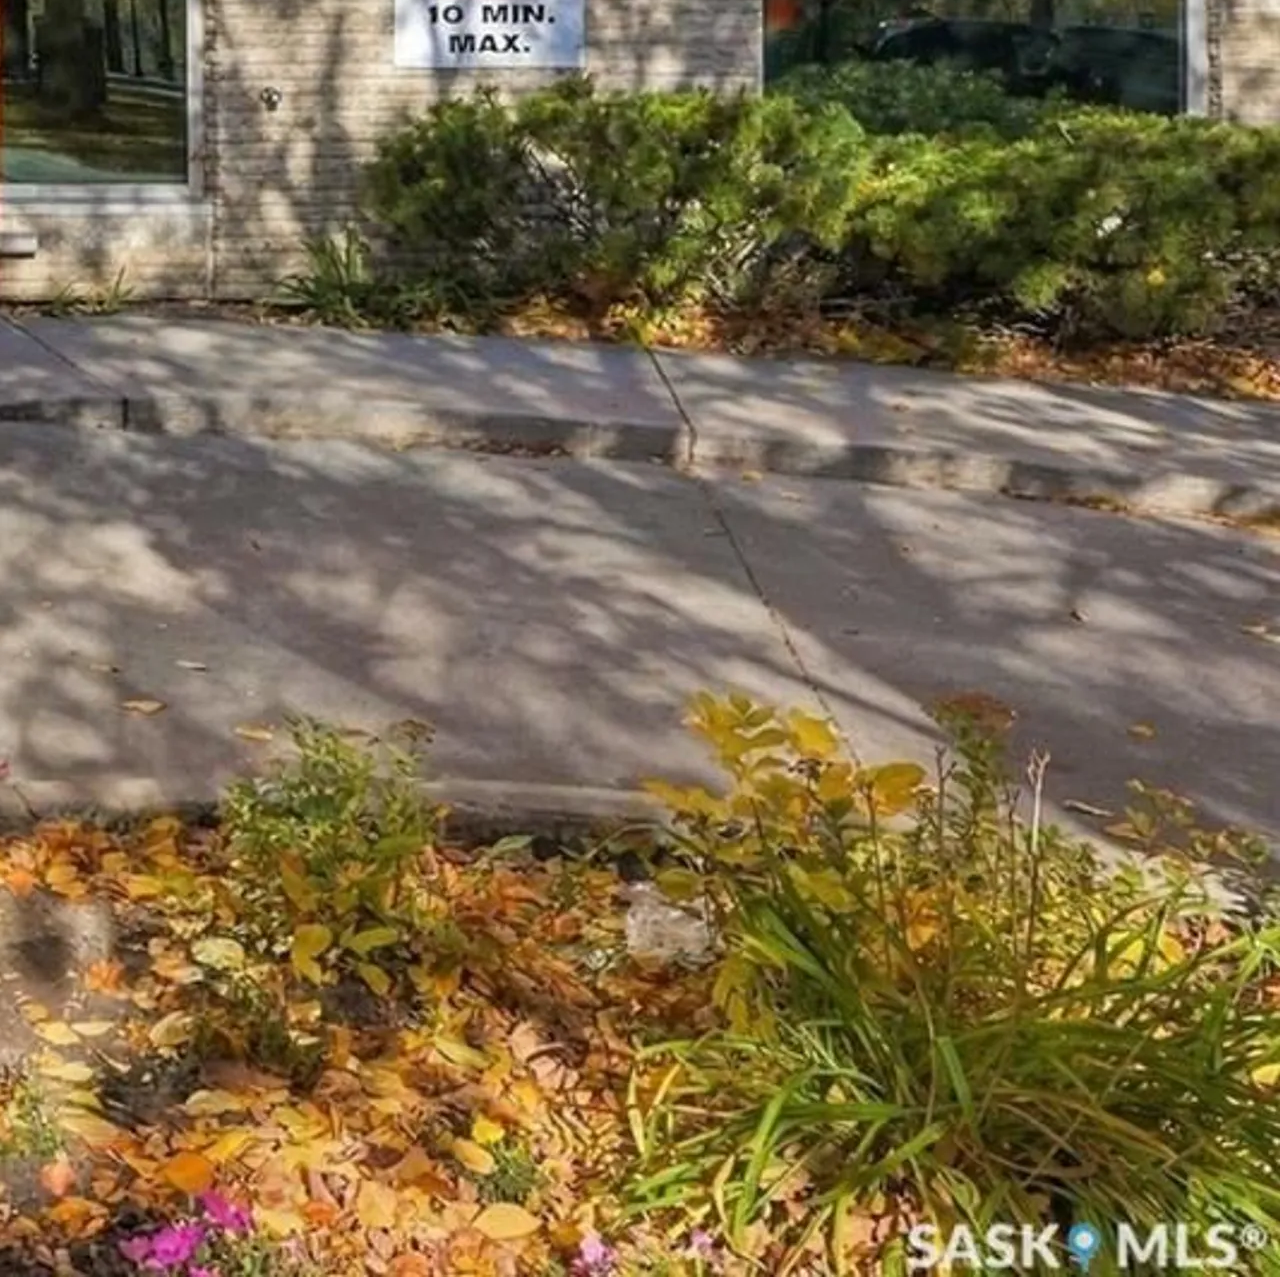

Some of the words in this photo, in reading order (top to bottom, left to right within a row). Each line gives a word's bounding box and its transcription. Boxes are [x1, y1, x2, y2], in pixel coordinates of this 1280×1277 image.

[428, 4, 464, 24] 10
[482, 4, 556, 24] MIN.
[449, 34, 531, 54] MAX.
